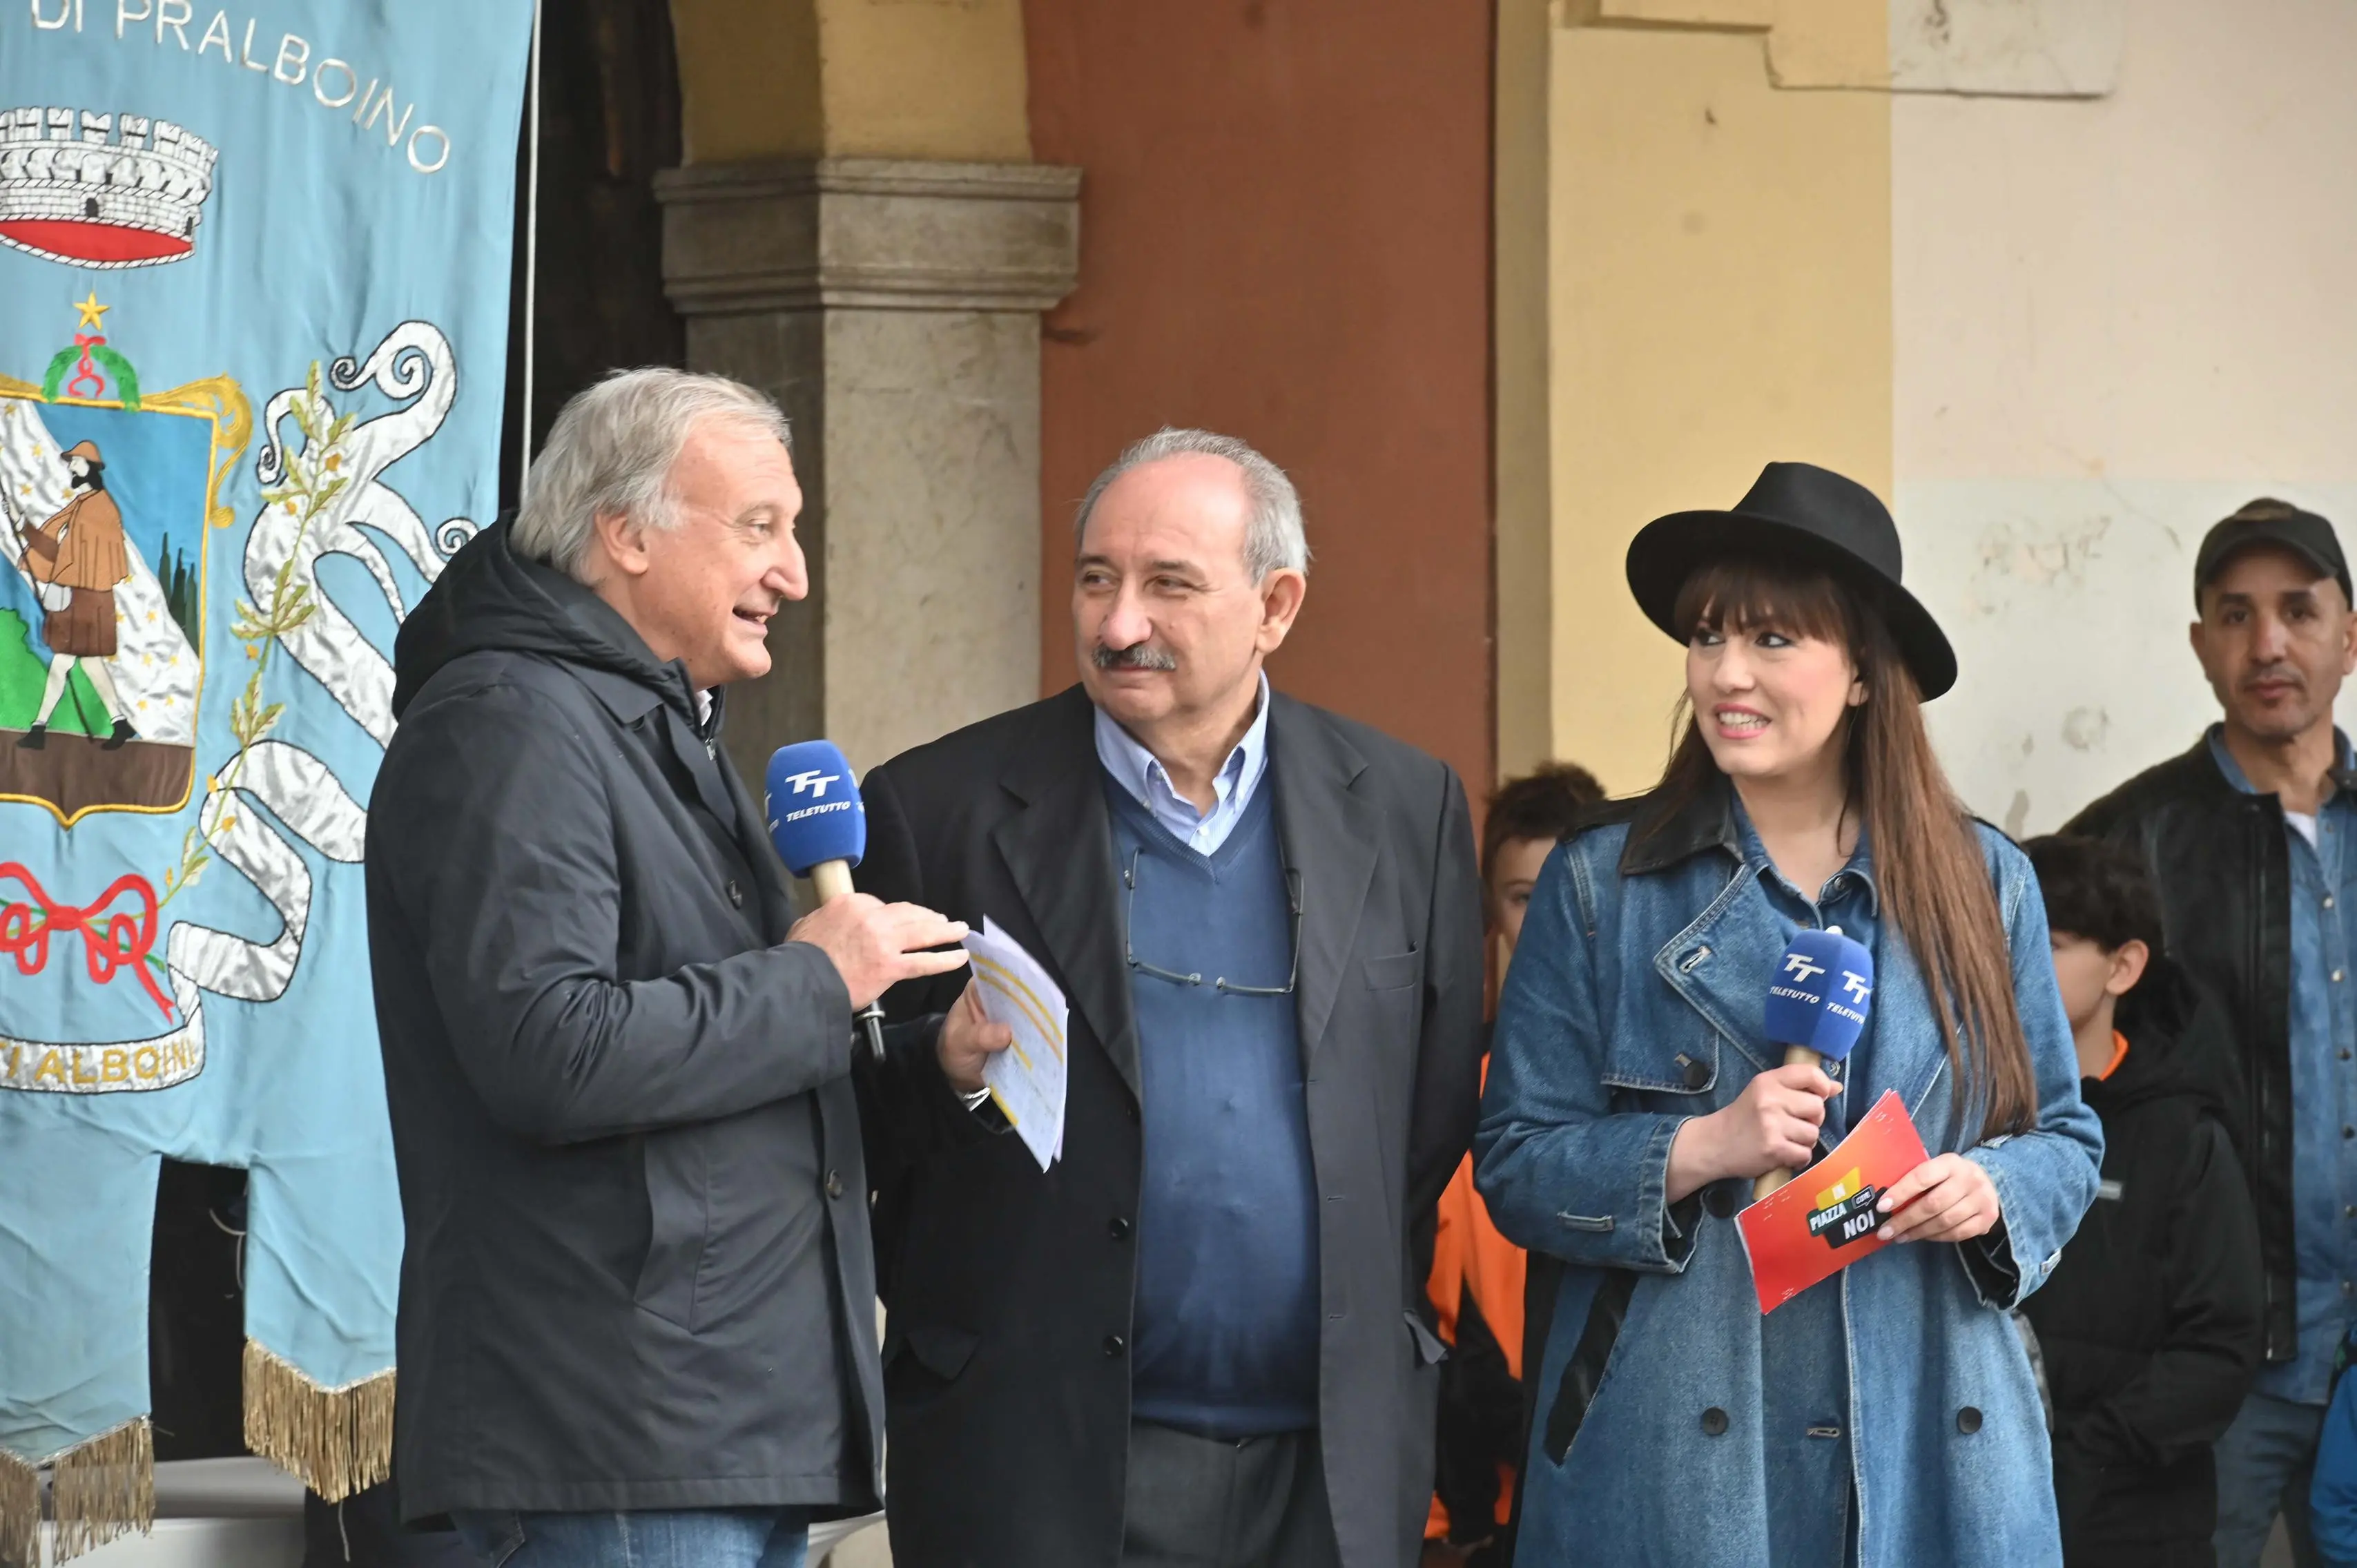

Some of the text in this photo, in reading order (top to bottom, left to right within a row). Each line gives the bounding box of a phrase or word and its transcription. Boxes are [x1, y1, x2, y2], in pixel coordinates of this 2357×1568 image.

[32, 0, 450, 174] DI PRALBOINO
[786, 801, 851, 822] TELETUTTO
[1769, 985, 1821, 1005] TELETUTTO
[35, 1038, 195, 1084] ALBOINI
[1810, 1202, 1847, 1232] PIAZZA
[1843, 1209, 1876, 1240] NOI
